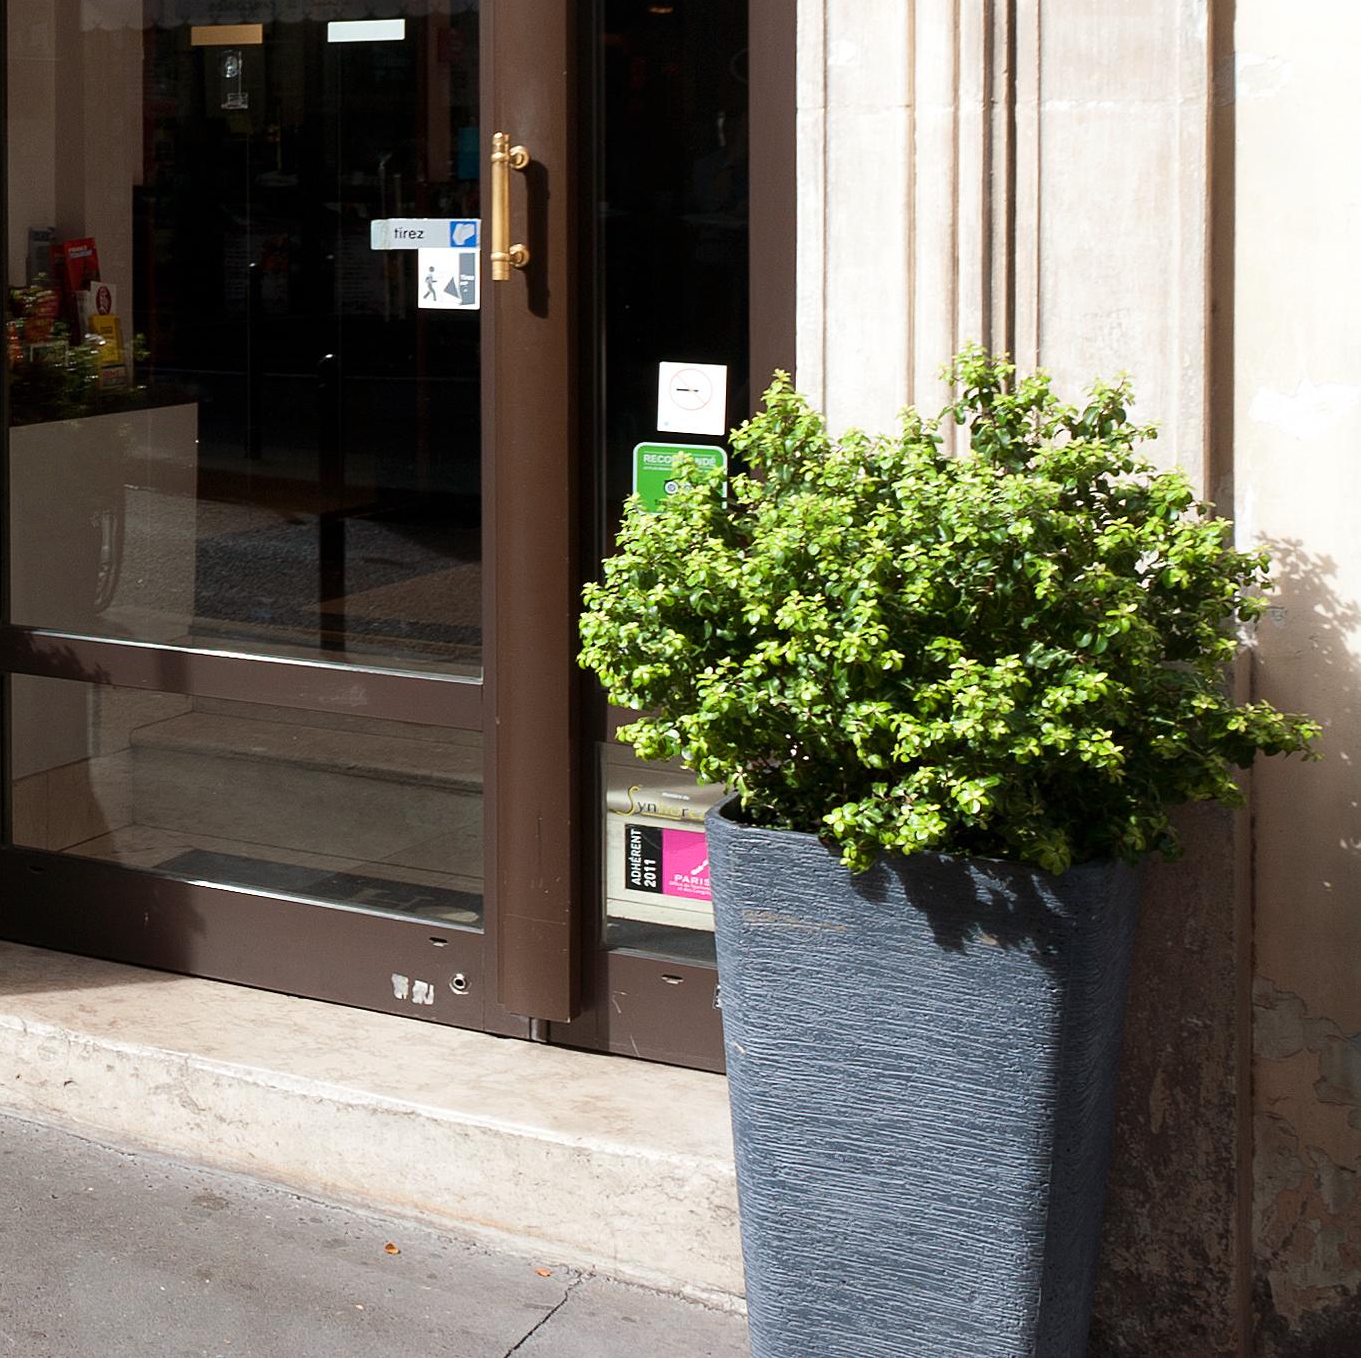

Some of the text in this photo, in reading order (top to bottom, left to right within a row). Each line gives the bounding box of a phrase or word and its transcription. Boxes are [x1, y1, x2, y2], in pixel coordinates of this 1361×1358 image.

[394, 227, 425, 240] tirez
[643, 453, 716, 466] RECONDÉ
[629, 828, 643, 886] ADHÉRENT
[644, 859, 657, 888] 2011
[674, 874, 711, 886] PARIS
